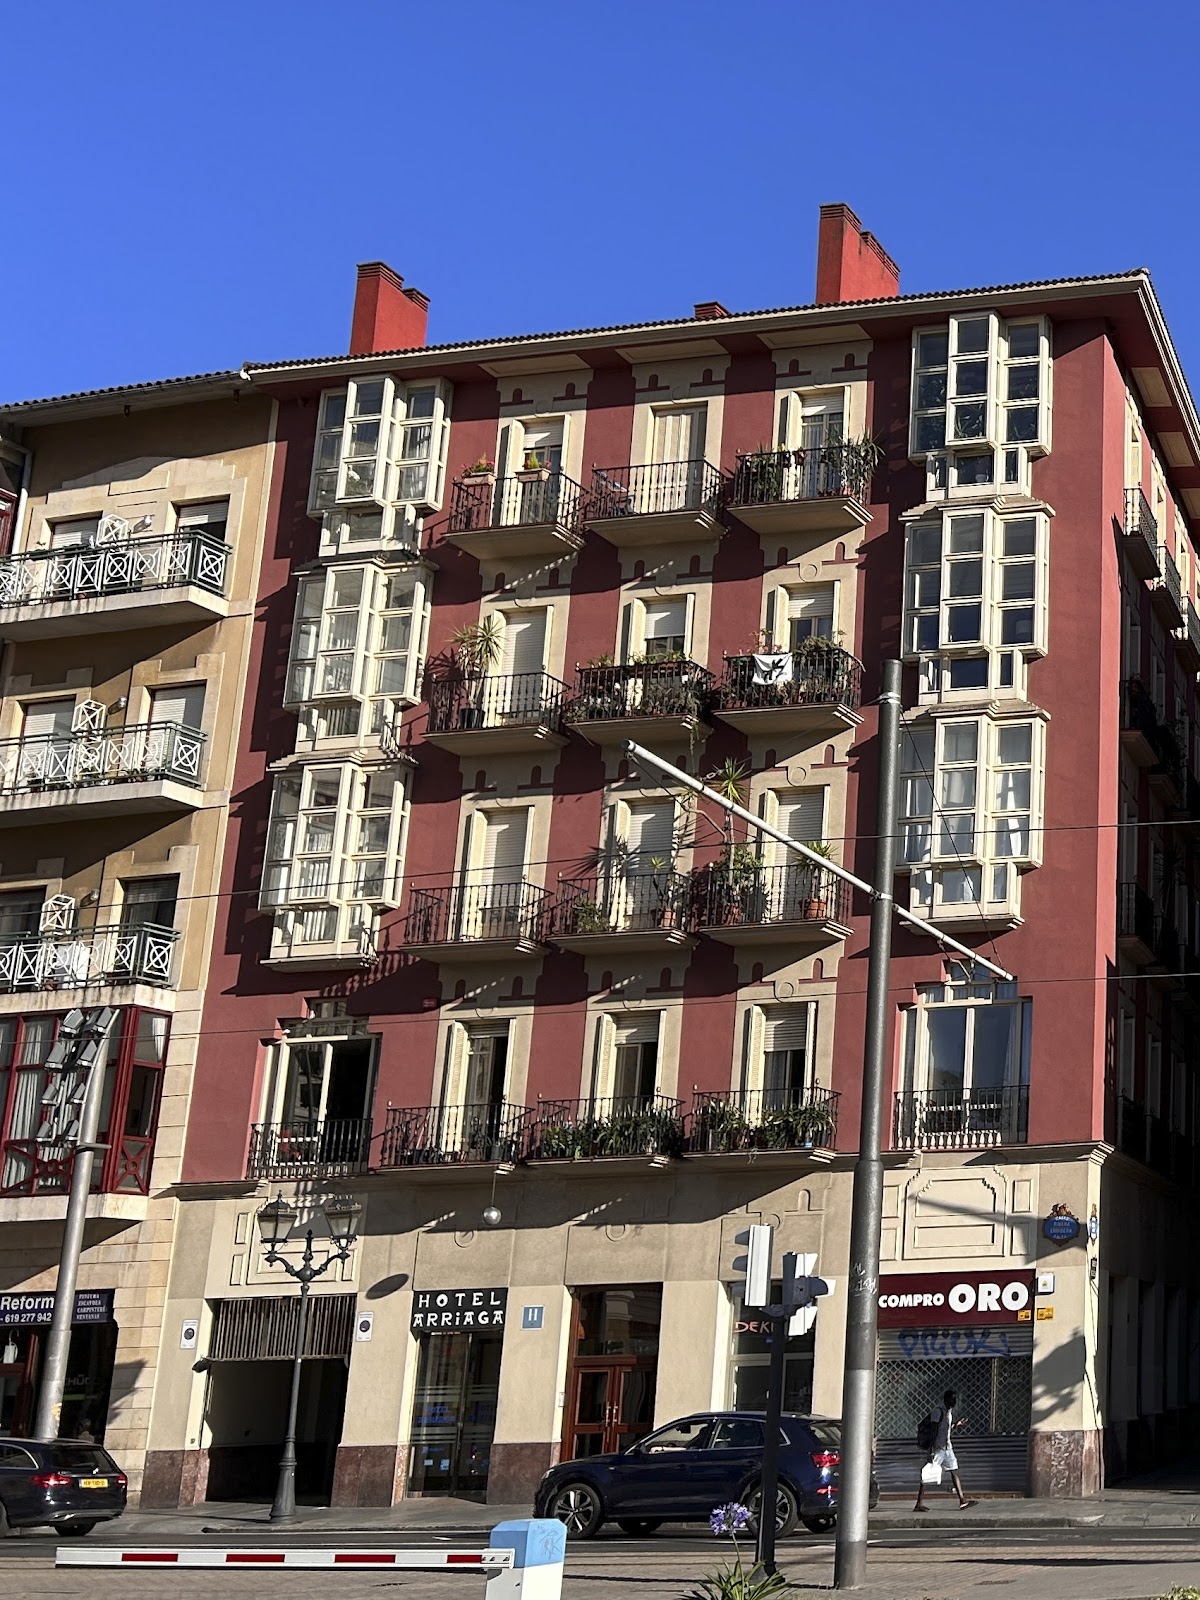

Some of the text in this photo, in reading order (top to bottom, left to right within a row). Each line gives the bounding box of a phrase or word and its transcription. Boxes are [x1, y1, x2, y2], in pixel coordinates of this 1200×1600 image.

[418, 1291, 501, 1308] HOTEL
[878, 1281, 1029, 1313] COMPRO ORO
[4, 1312, 52, 1323] 619 277 942
